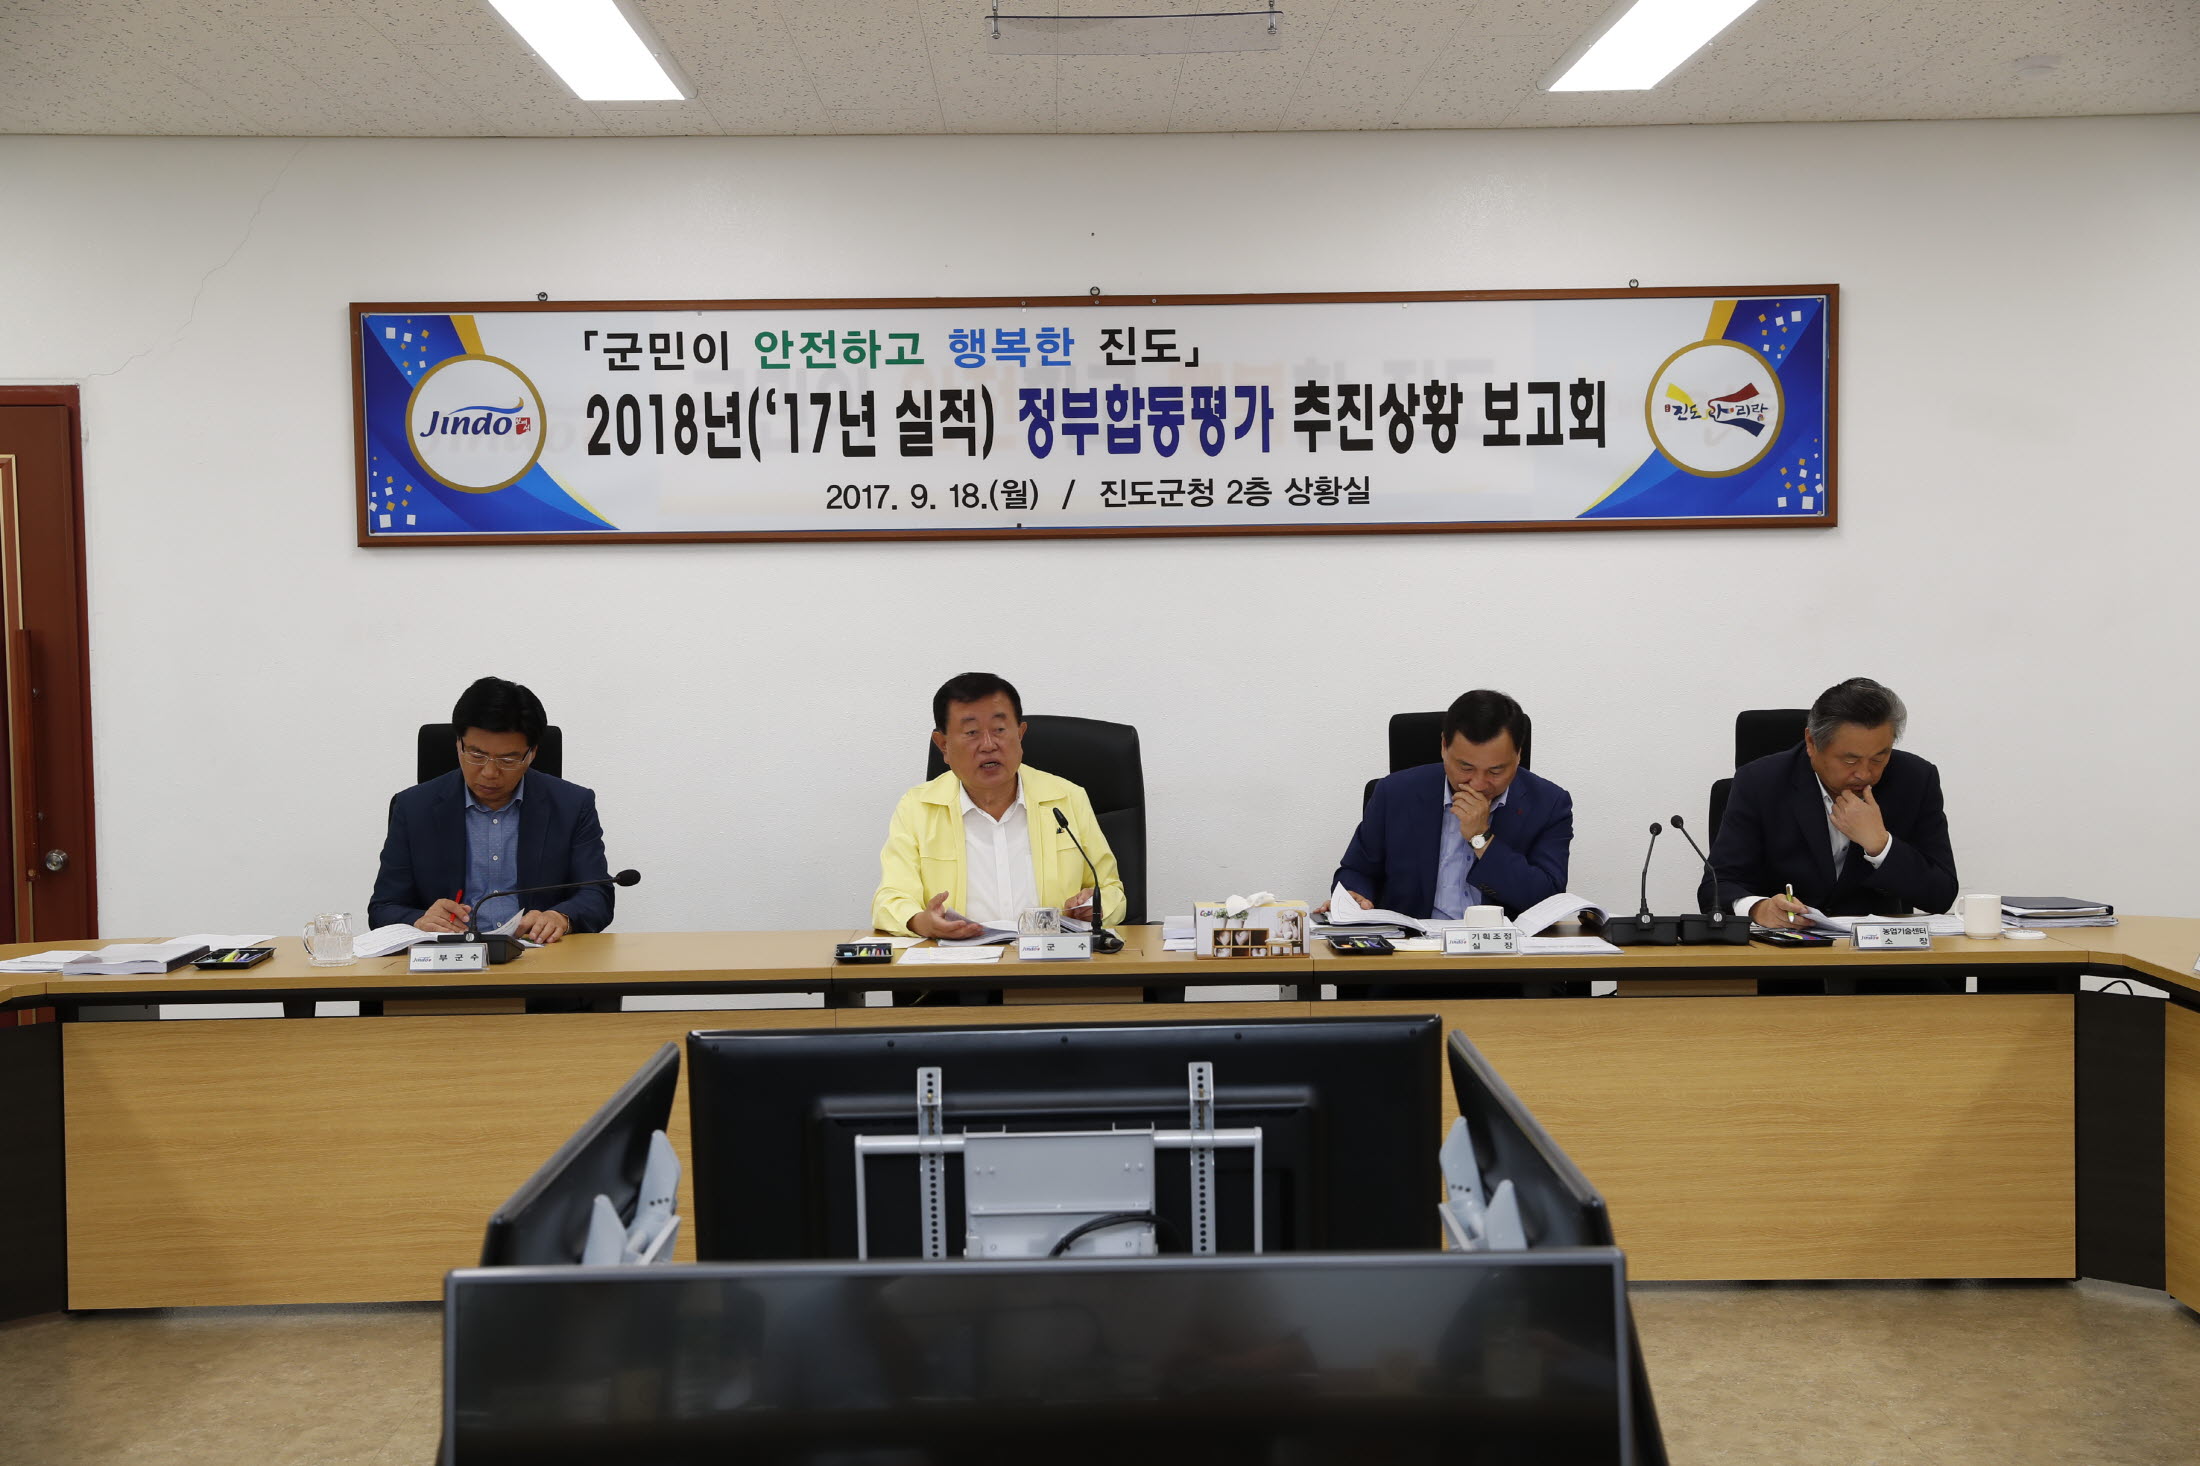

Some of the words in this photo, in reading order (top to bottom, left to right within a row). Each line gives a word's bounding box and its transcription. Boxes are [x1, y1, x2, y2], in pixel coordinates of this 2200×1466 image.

[754, 329, 925, 369] 안전하고
[948, 327, 1075, 368] 행복한
[420, 411, 513, 437] Jindo
[895, 384, 994, 461] 실적)
[1018, 384, 1275, 460] 정부합동평가
[1293, 380, 1464, 454] 추진상황
[1482, 377, 1606, 449] 보고회
[827, 485, 898, 511] 2017.
[910, 484, 936, 510] 9.
[949, 479, 1039, 511] 18.(월)
[1100, 479, 1214, 508] 진도군청
[1226, 477, 1273, 507] 2층
[1284, 475, 1370, 507] 상황실
[1882, 927, 1927, 935] 농업기술센터
